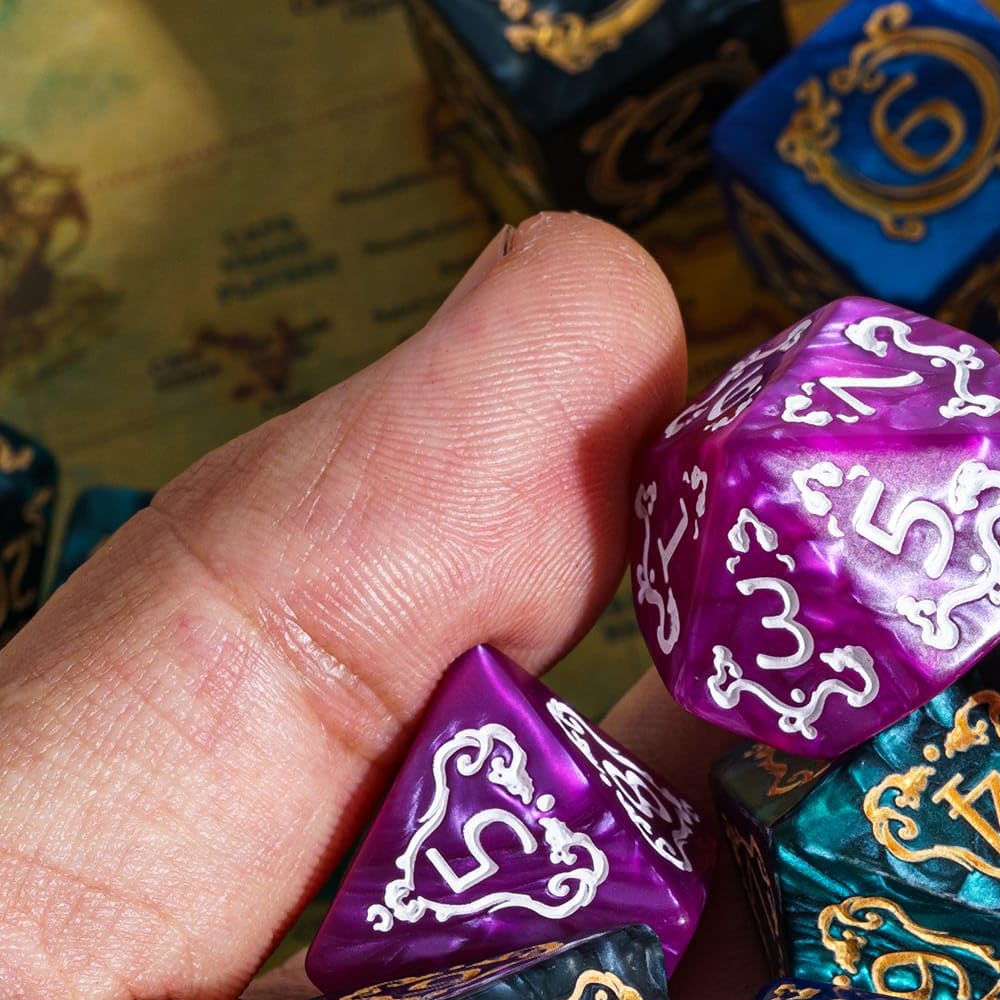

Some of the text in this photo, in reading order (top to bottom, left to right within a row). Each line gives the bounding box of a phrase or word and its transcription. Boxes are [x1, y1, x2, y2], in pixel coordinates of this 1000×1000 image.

[853, 478, 955, 579] 5
[736, 577, 814, 670] 3
[426, 808, 538, 893] 5
